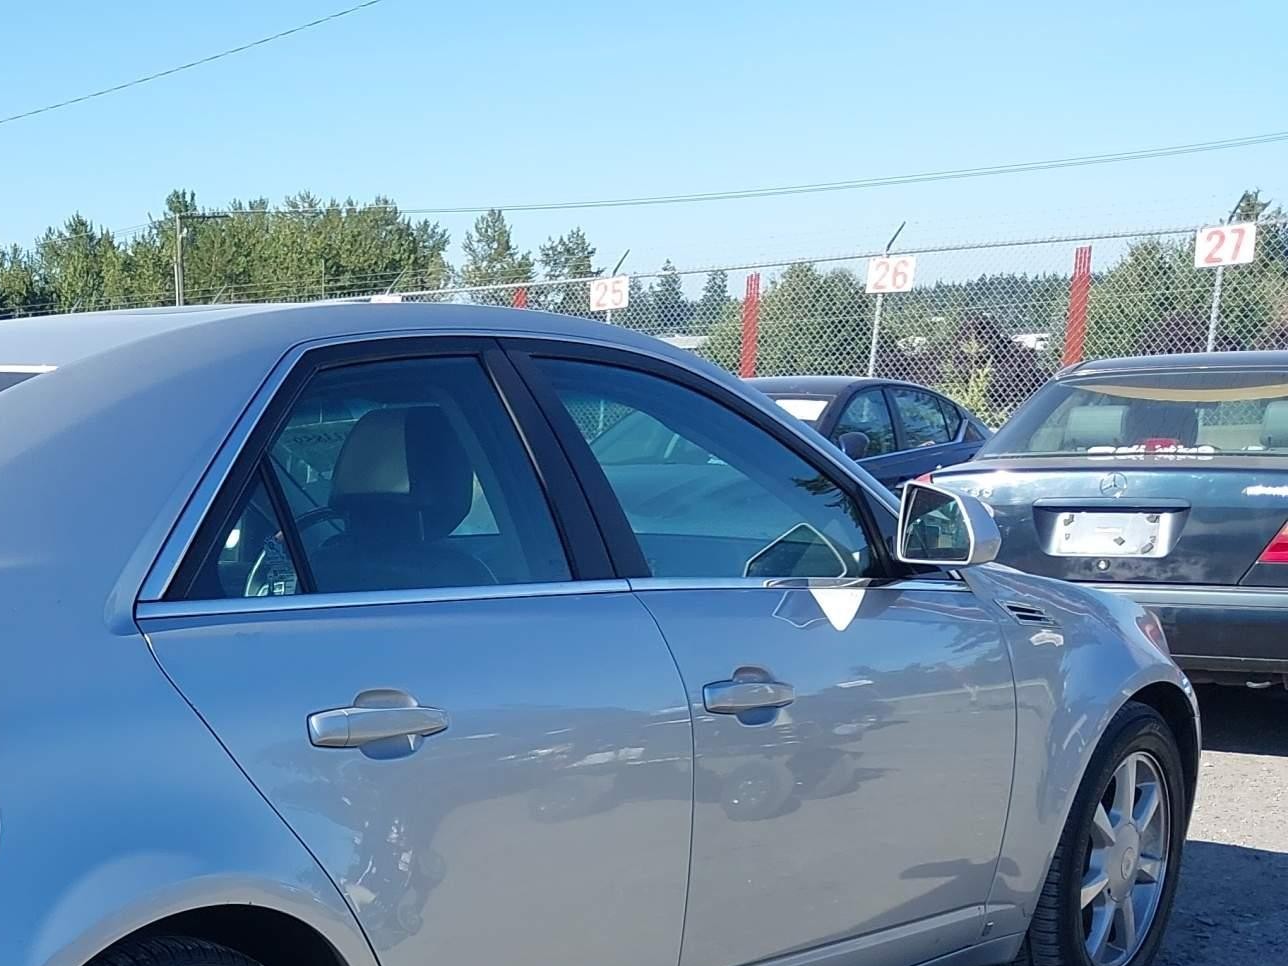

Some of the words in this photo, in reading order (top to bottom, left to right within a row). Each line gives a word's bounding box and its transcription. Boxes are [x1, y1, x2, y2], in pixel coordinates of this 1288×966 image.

[1205, 228, 1245, 263] 27
[872, 260, 909, 290] 26
[596, 280, 623, 307] 25
